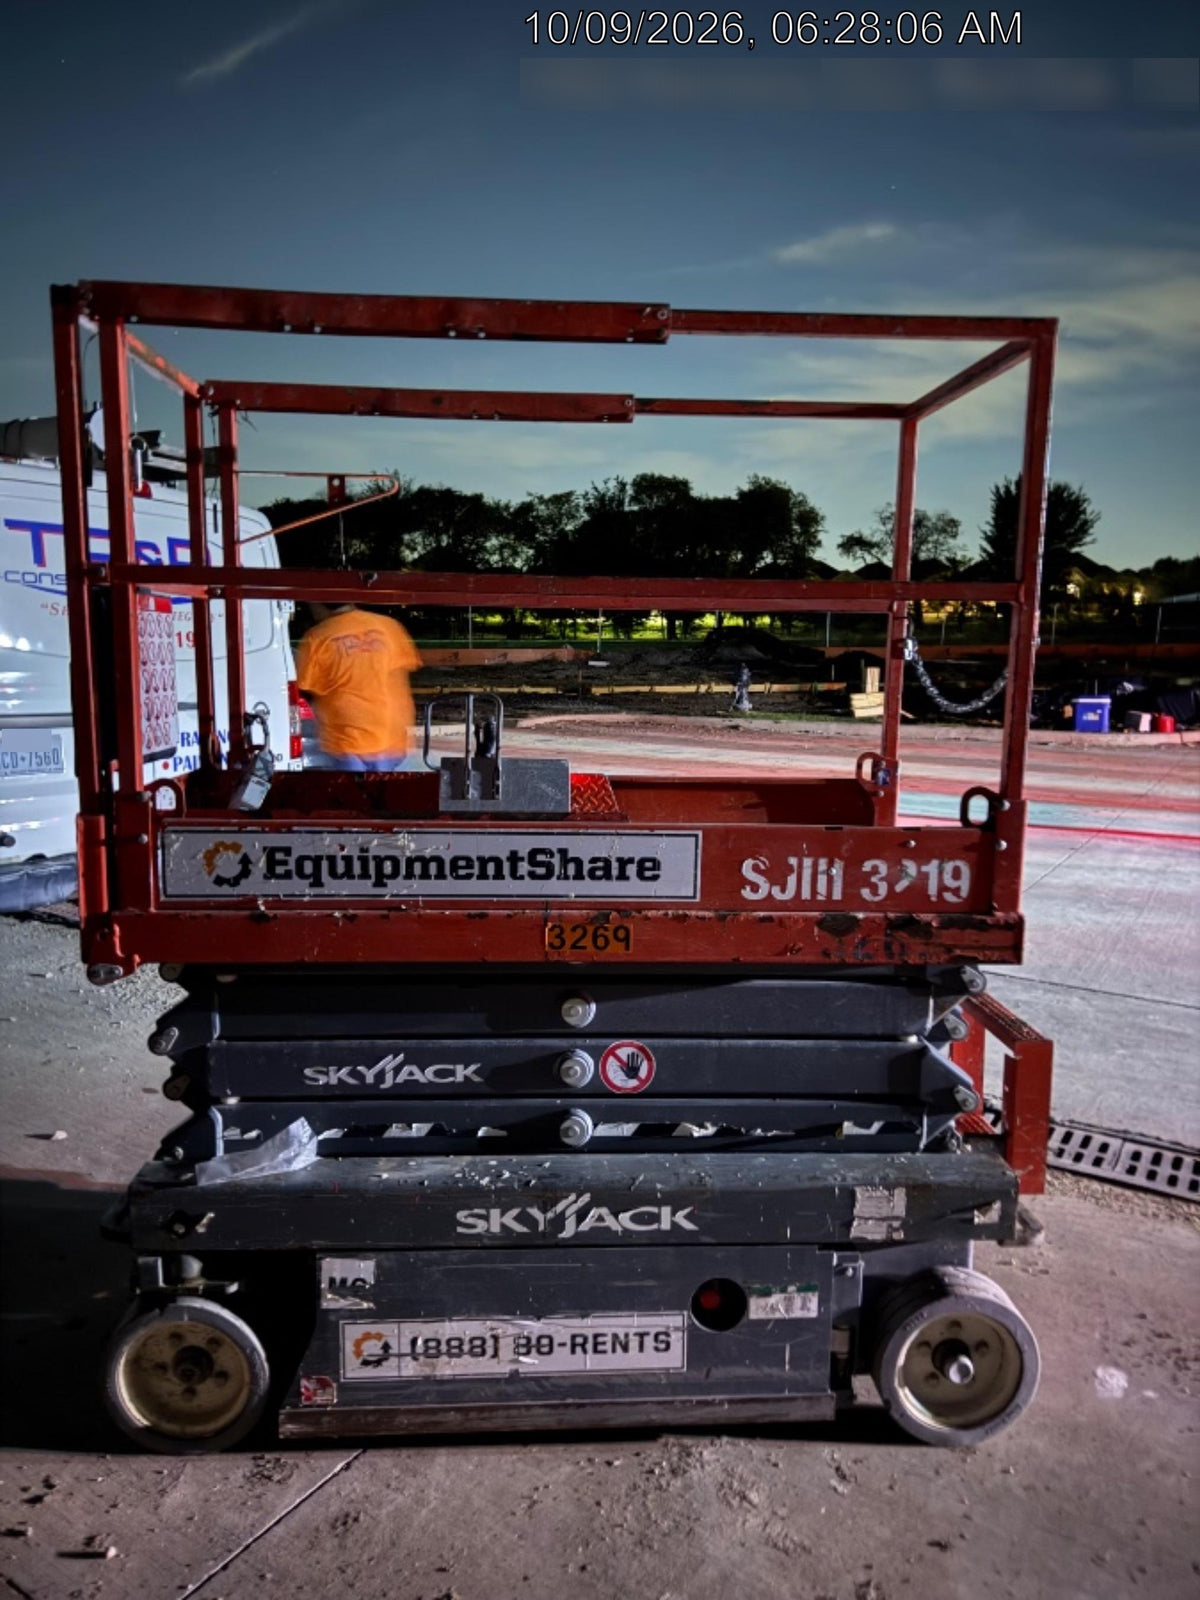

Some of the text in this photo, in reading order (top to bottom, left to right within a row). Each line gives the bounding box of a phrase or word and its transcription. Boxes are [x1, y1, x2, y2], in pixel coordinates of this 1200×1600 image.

[262, 845, 662, 888] EquipmentShare
[547, 923, 632, 952] 3269
[303, 1053, 485, 1089] SKYJACK
[455, 1192, 700, 1239] SKYJACK
